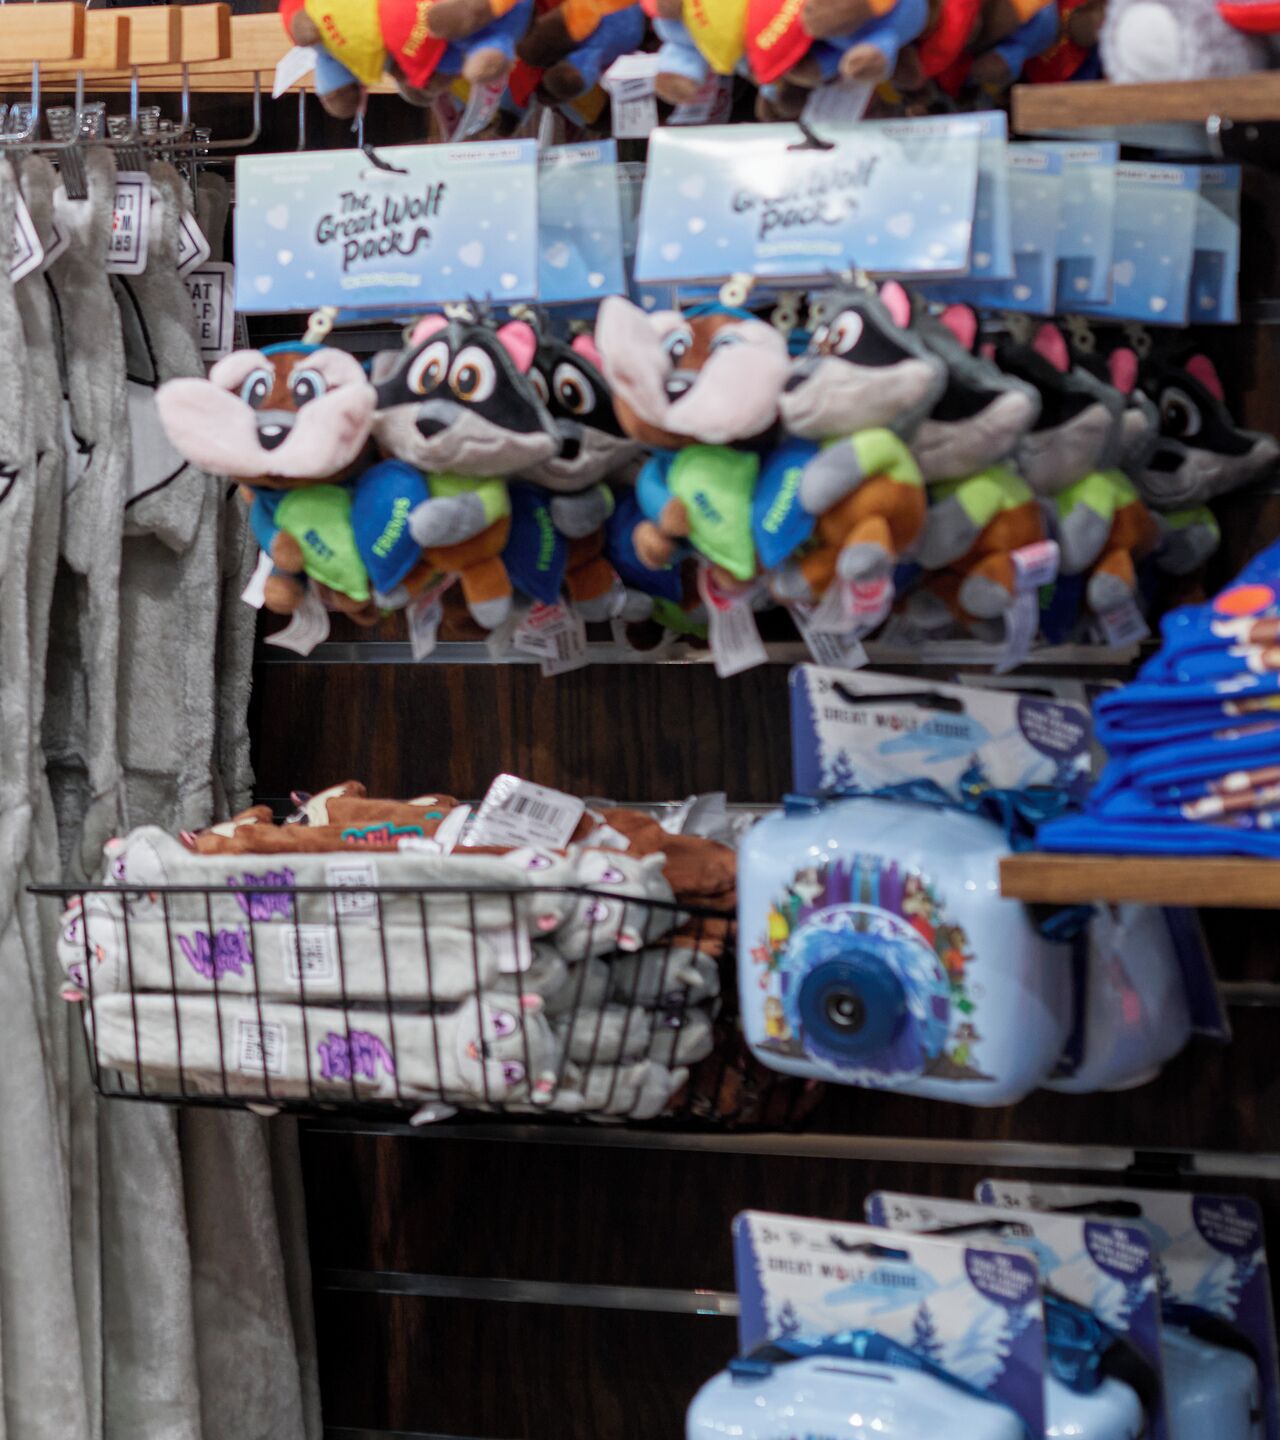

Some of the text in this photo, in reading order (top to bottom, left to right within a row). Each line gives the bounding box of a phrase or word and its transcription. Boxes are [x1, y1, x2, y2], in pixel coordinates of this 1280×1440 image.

[340, 192, 370, 213] The
[316, 182, 446, 244] Great Wolf
[824, 707, 868, 726] GREAT
[767, 1256, 813, 1276] GREAT
